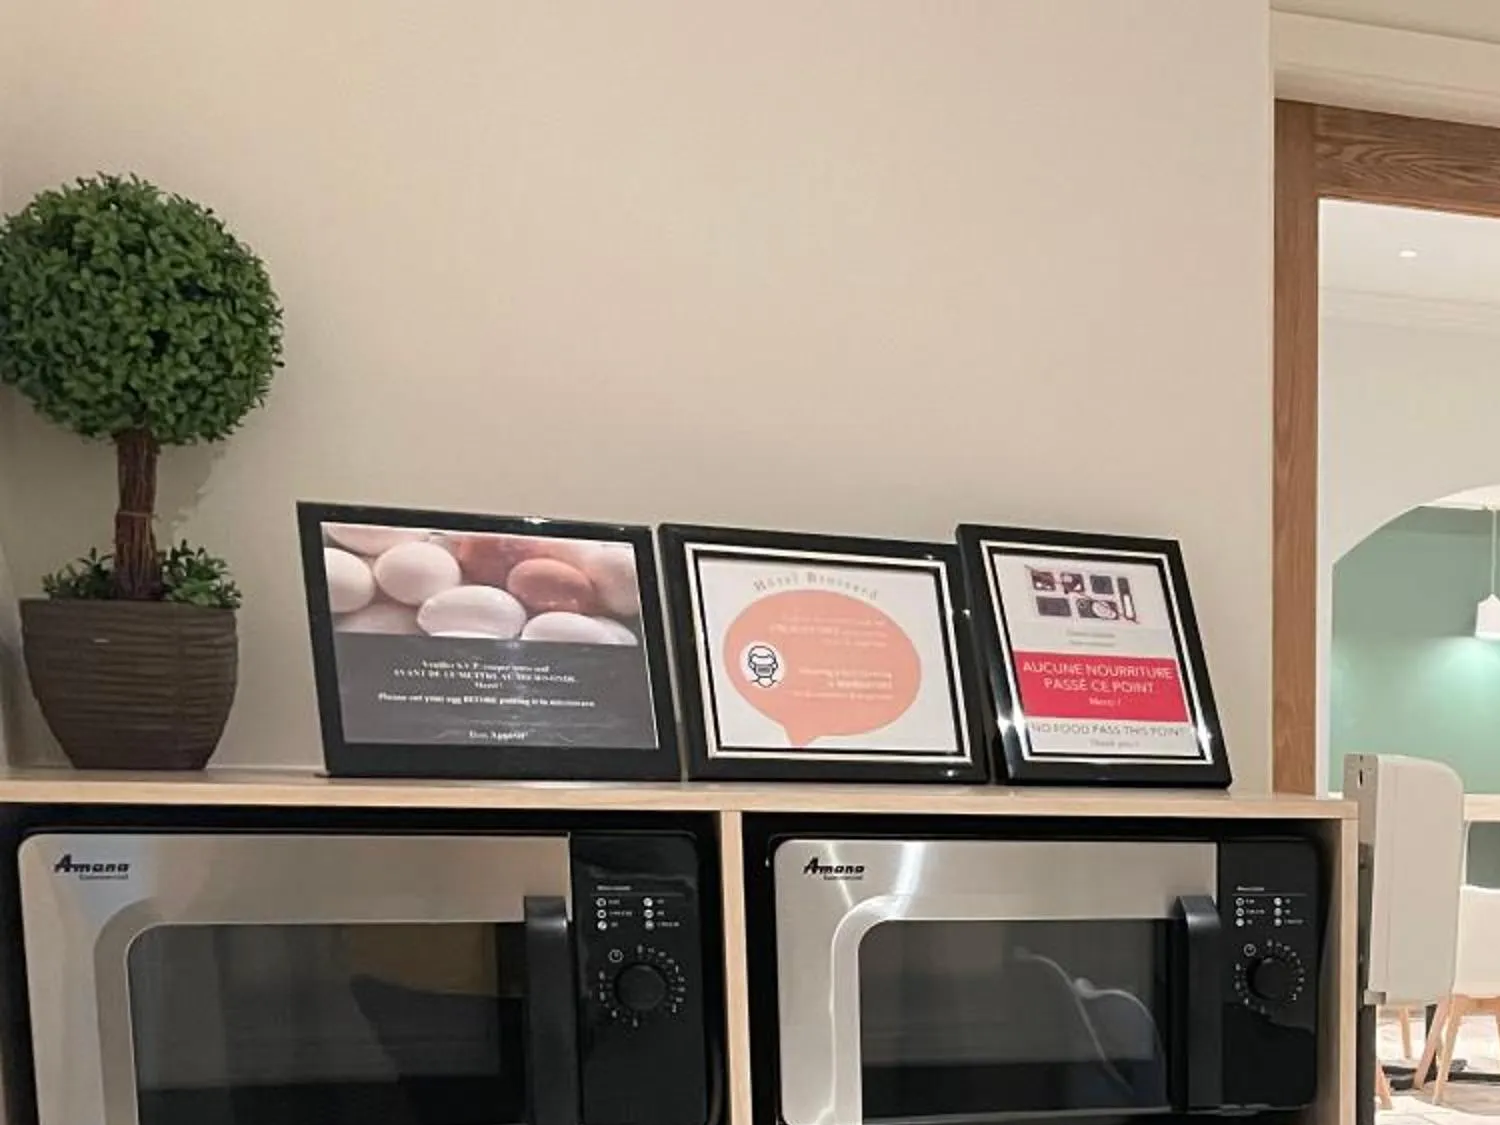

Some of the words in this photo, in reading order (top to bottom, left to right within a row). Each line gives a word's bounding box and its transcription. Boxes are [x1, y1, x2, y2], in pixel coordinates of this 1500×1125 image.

[1023, 661, 1083, 675] AUCUNE
[1086, 663, 1174, 681] NOURRITURE
[1112, 680, 1154, 693] POINT
[54, 853, 130, 873] Amana
[803, 856, 865, 875] Amana
